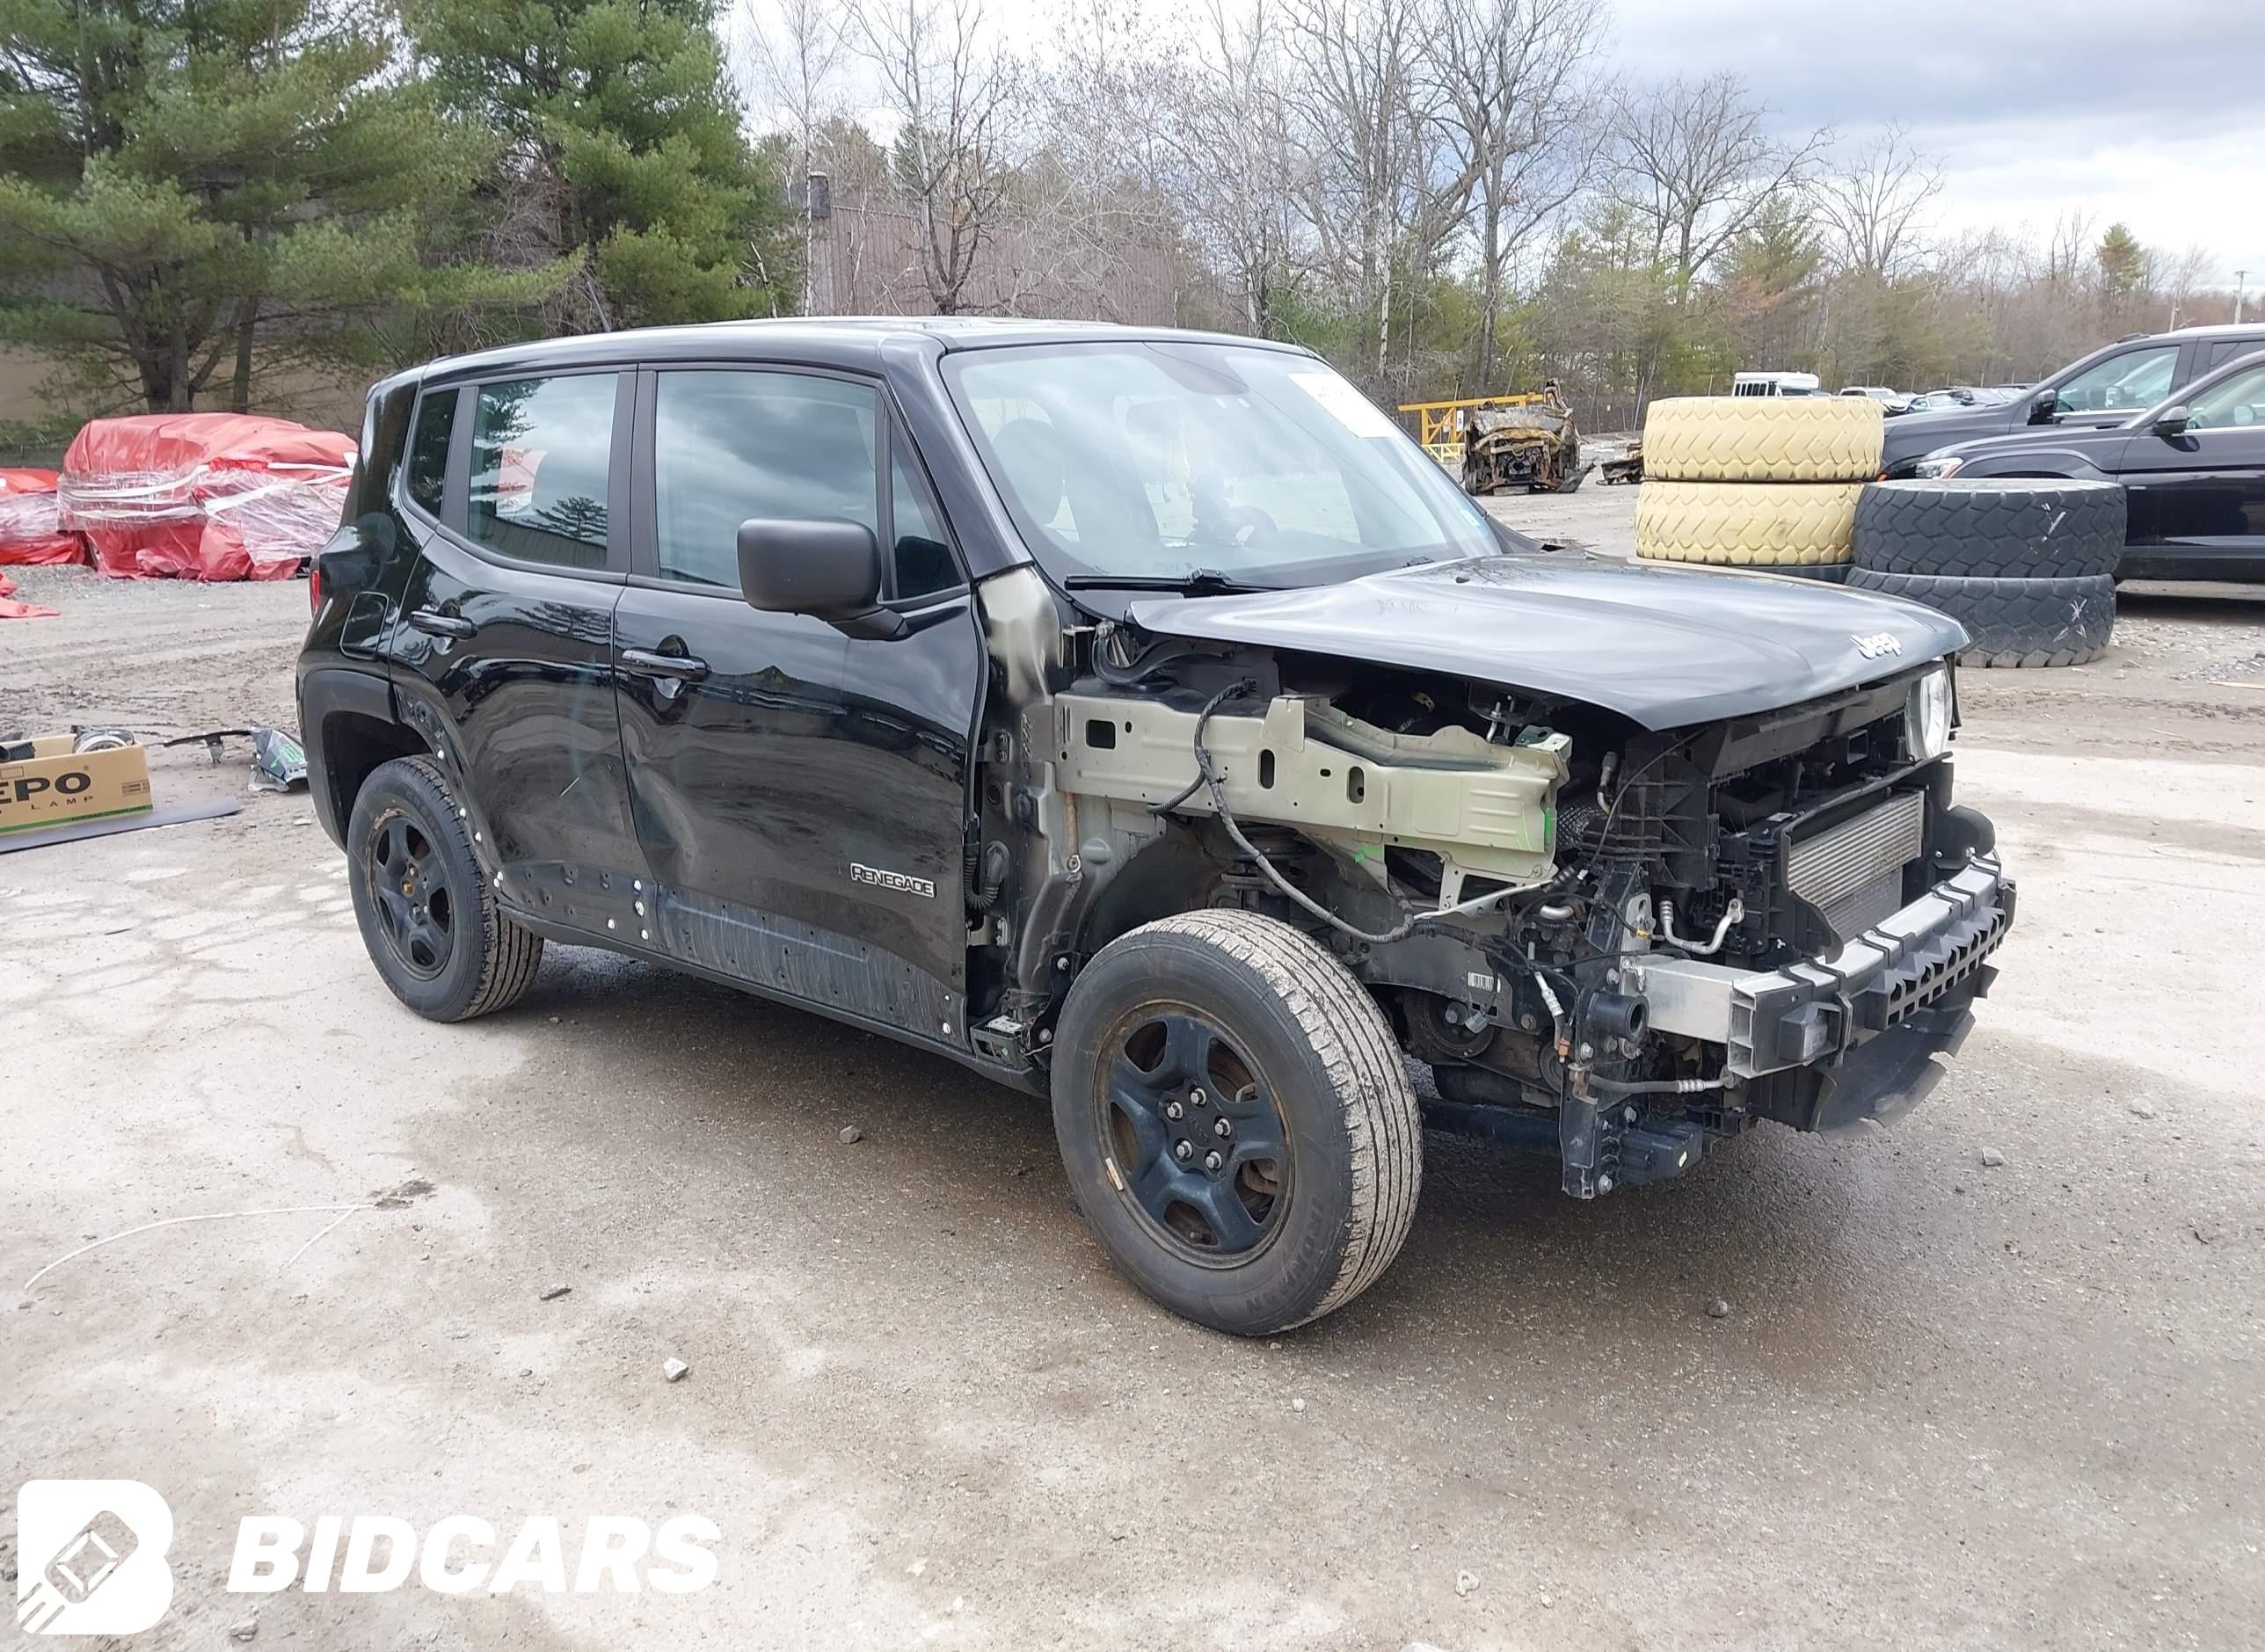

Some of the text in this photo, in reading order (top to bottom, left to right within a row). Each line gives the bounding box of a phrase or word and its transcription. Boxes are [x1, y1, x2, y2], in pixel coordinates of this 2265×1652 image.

[1850, 632, 1903, 660] Jeep
[31, 795, 94, 811] LAMP
[850, 862, 935, 899] RENEGADE
